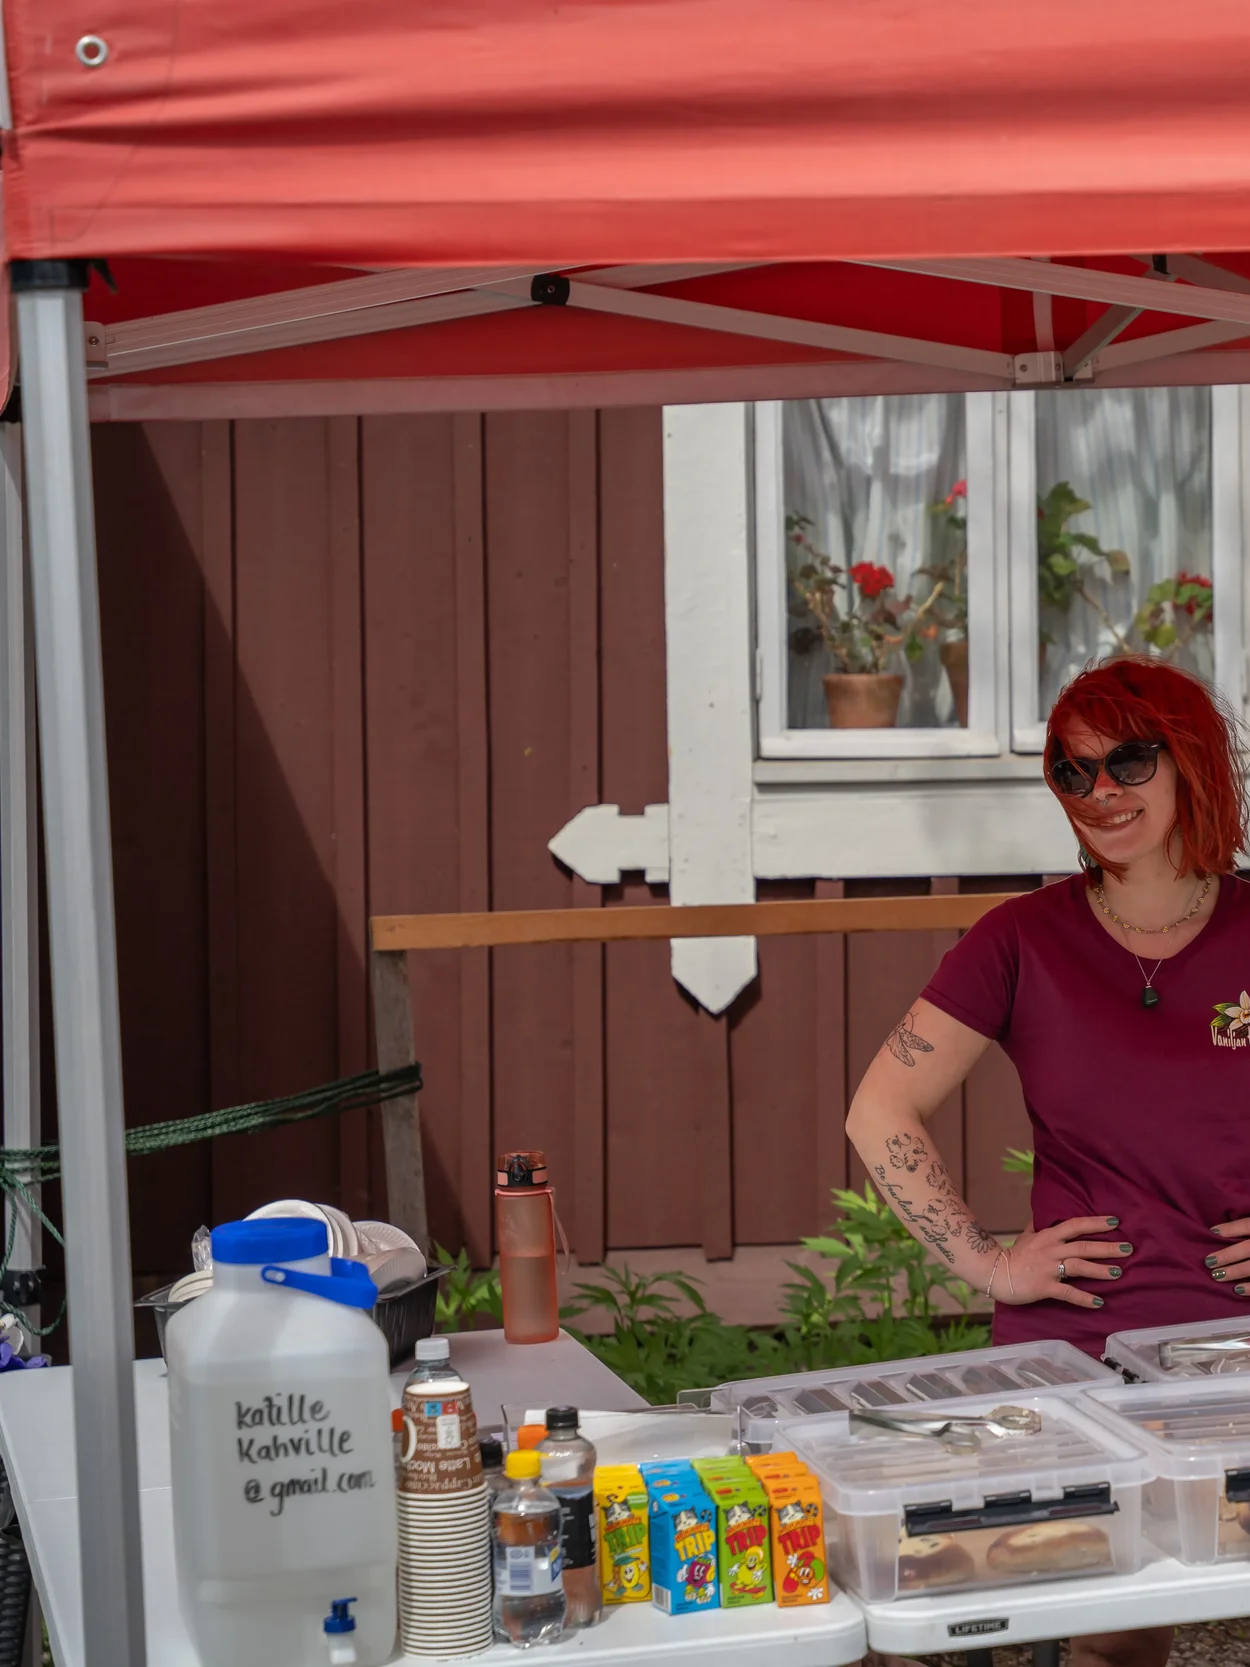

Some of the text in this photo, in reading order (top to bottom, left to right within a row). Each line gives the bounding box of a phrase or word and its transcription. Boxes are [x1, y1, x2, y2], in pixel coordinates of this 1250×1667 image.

[1210, 1026, 1246, 1050] Vaniljan
[244, 1467, 376, 1517] @ gmail.com
[605, 1524, 646, 1554] TRIP
[674, 1528, 716, 1562] TRIP
[726, 1524, 767, 1556] TRIP
[778, 1524, 821, 1556] TRIP
[955, 1620, 1001, 1634] LIFETIME
